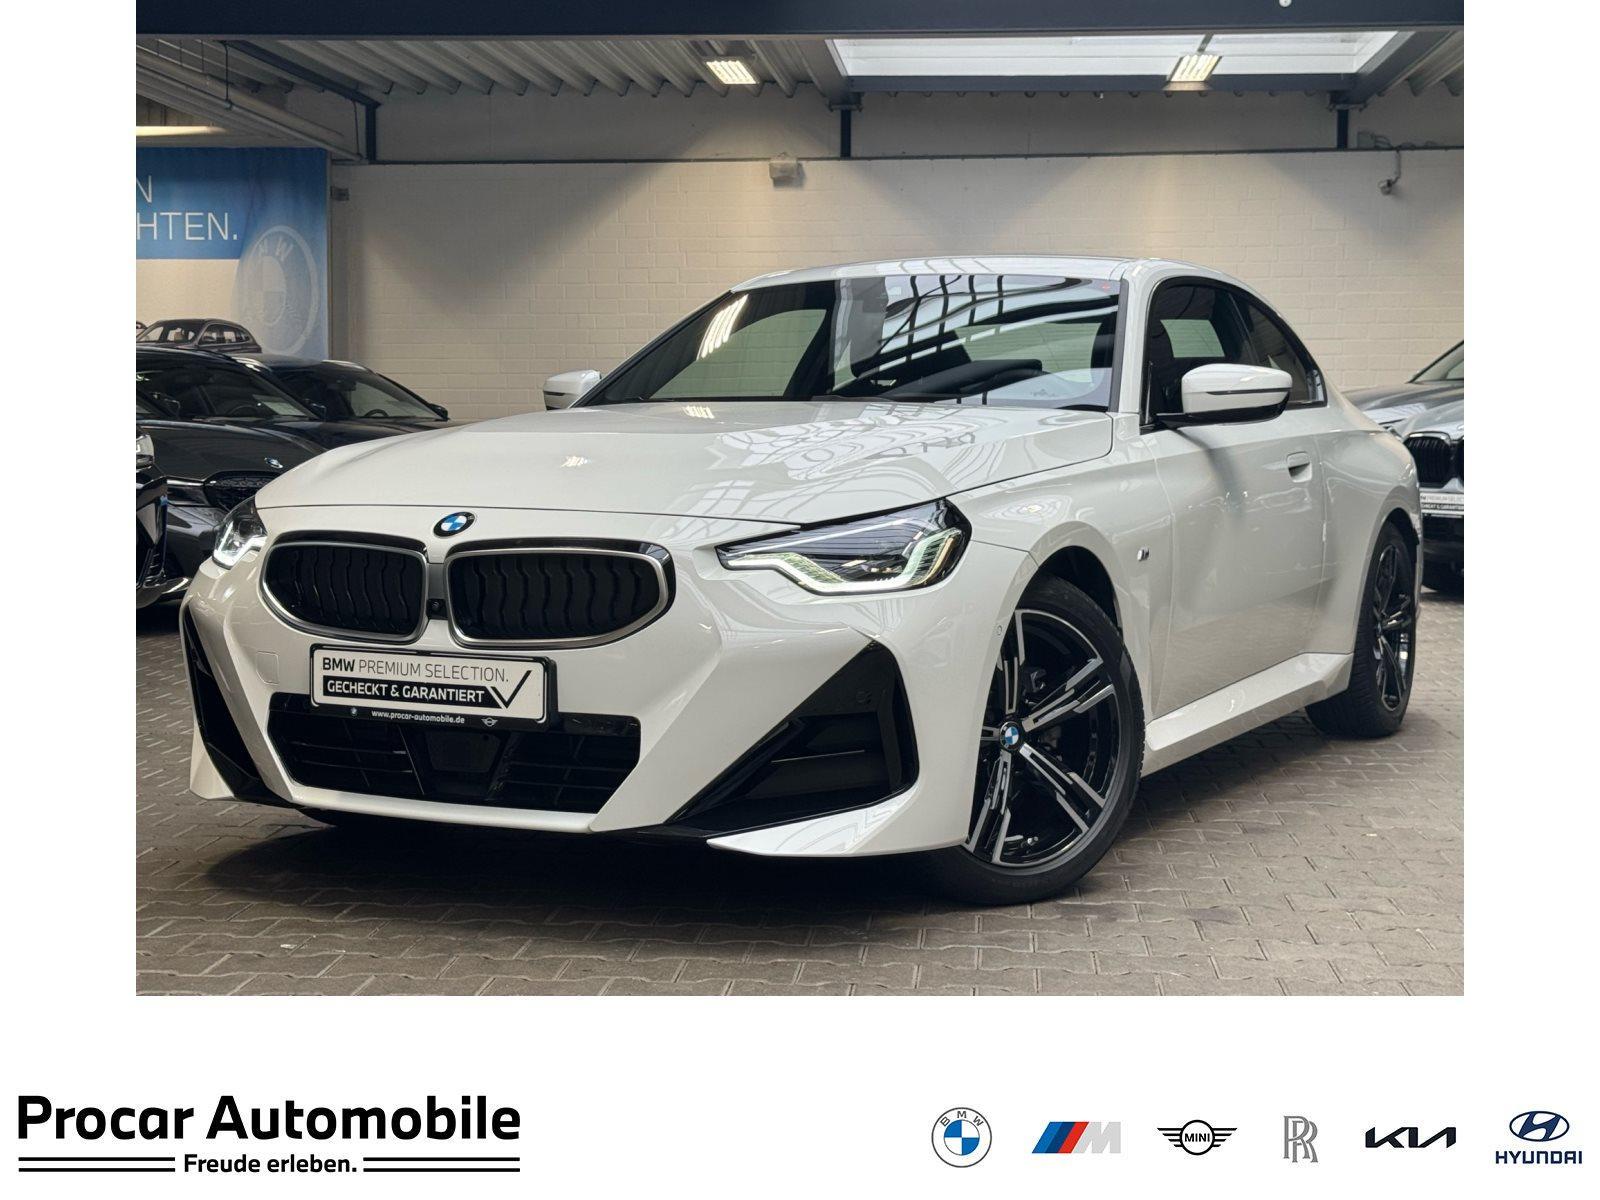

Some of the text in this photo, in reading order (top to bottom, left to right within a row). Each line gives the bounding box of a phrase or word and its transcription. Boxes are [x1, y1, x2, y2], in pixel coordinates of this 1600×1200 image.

[322, 657, 509, 682] BMW PREMIUM SELECTION.
[327, 680, 485, 703] GECHECKT & GARANTIERT
[371, 710, 465, 724] www.procar-automobile.de
